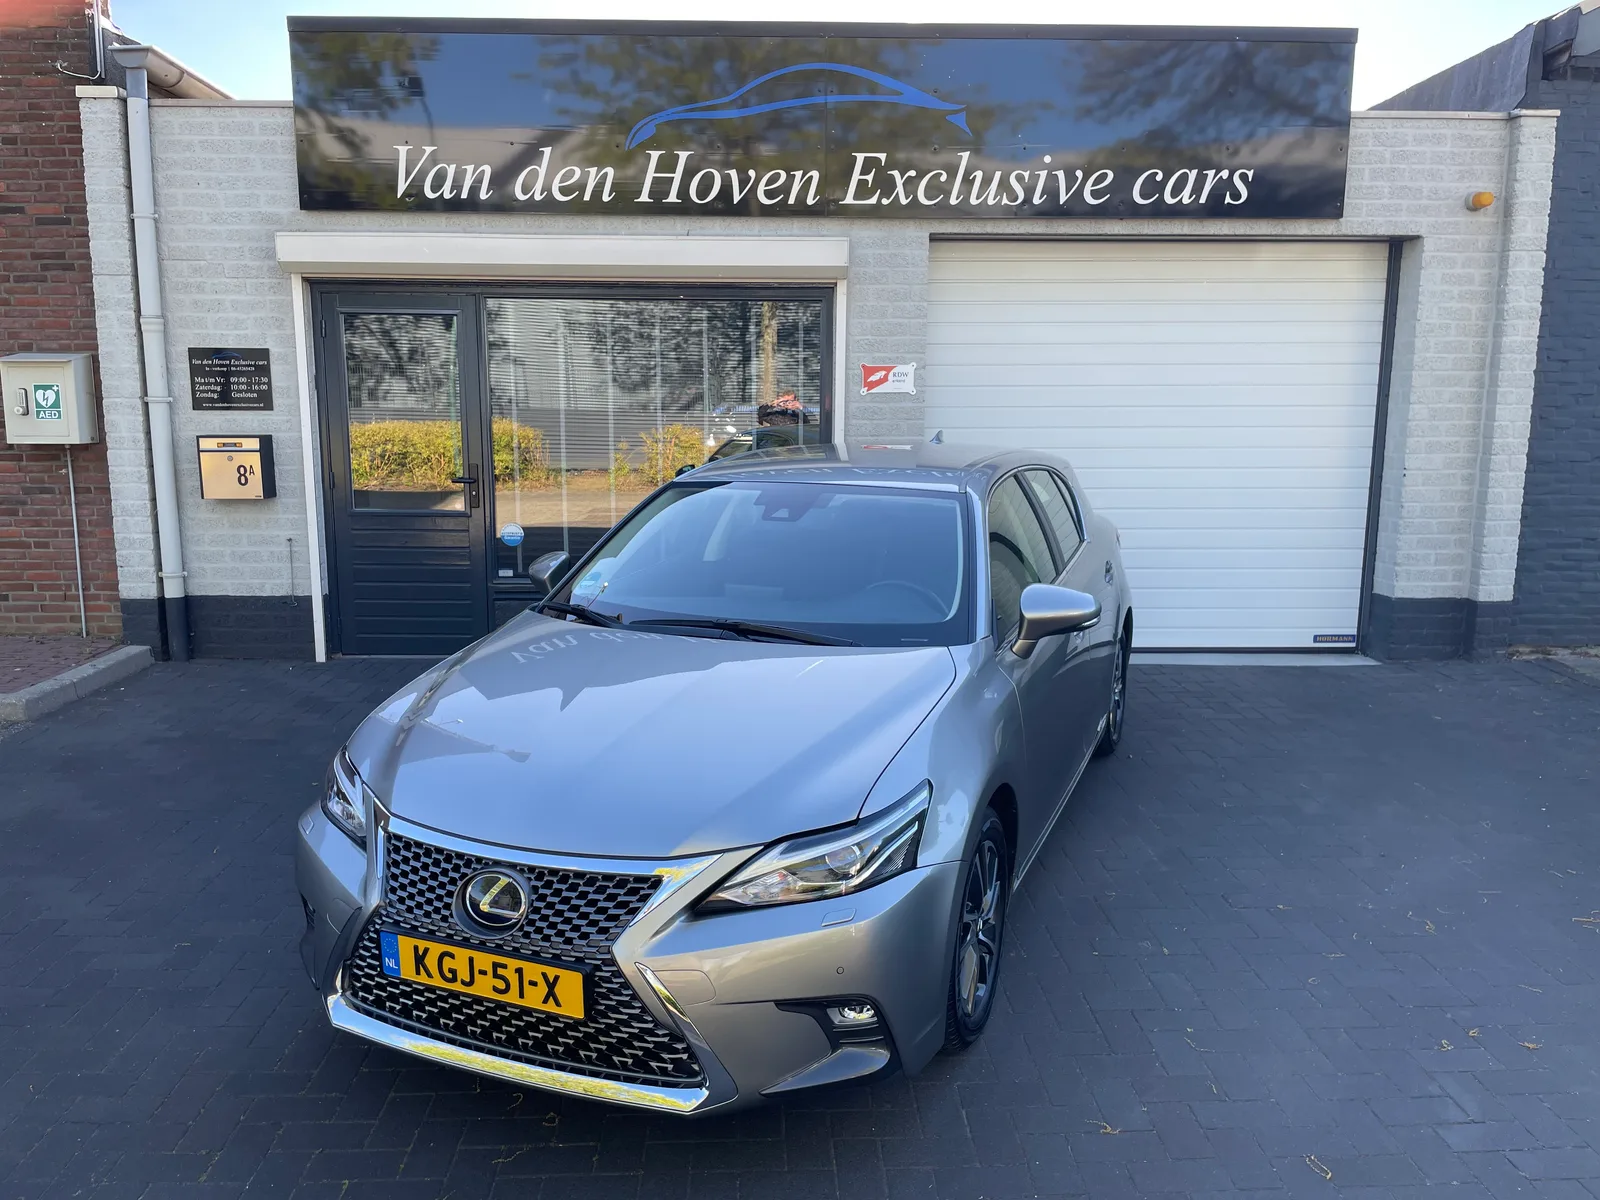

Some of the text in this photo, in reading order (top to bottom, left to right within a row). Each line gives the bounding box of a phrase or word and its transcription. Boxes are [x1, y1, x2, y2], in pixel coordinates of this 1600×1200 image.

[393, 145, 1254, 206] Van den Hoven Exclusive cars
[39, 411, 59, 419] AED
[385, 957, 399, 969] NL
[413, 944, 563, 1008] KGJ-51-X
